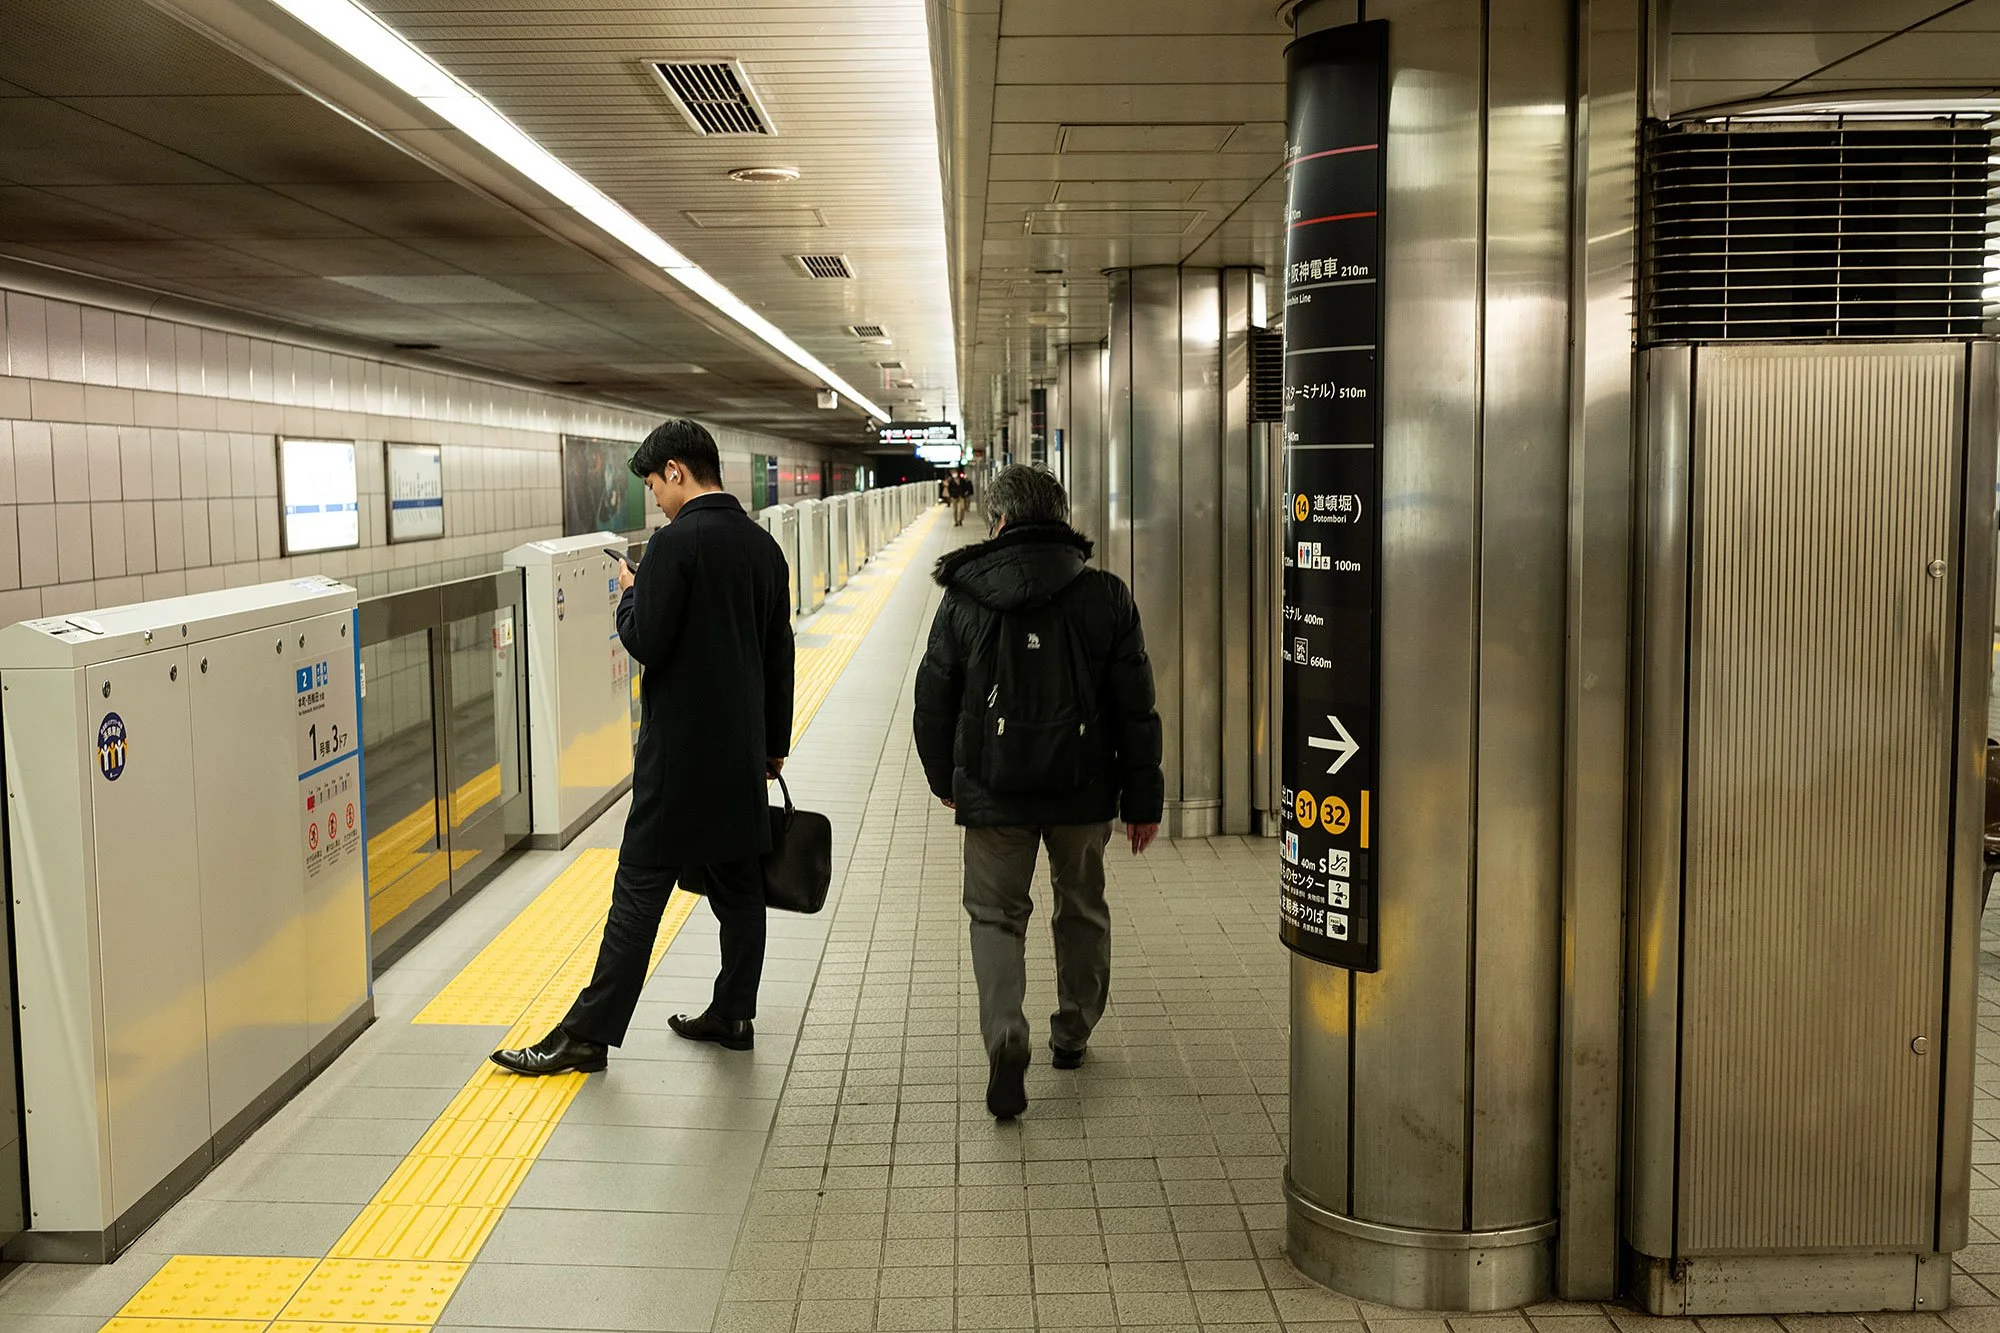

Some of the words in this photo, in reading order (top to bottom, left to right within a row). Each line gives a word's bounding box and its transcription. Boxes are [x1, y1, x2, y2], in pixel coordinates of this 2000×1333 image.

[1341, 265, 1369, 277] 210m
[1299, 293, 1312, 304] Line
[1339, 387, 1367, 399] 510m
[1296, 500, 1308, 515] 14
[1313, 494, 1352, 512] 道頓堀
[1312, 514, 1347, 523] Dotombori
[1334, 560, 1361, 572] 100m
[1303, 613, 1324, 626] 400m
[1310, 656, 1332, 669] 660m
[302, 671, 308, 688] 2
[1298, 797, 1313, 821] 31
[1324, 803, 1346, 827] 32
[1301, 857, 1316, 871] 40m
[1319, 857, 1327, 874] S
